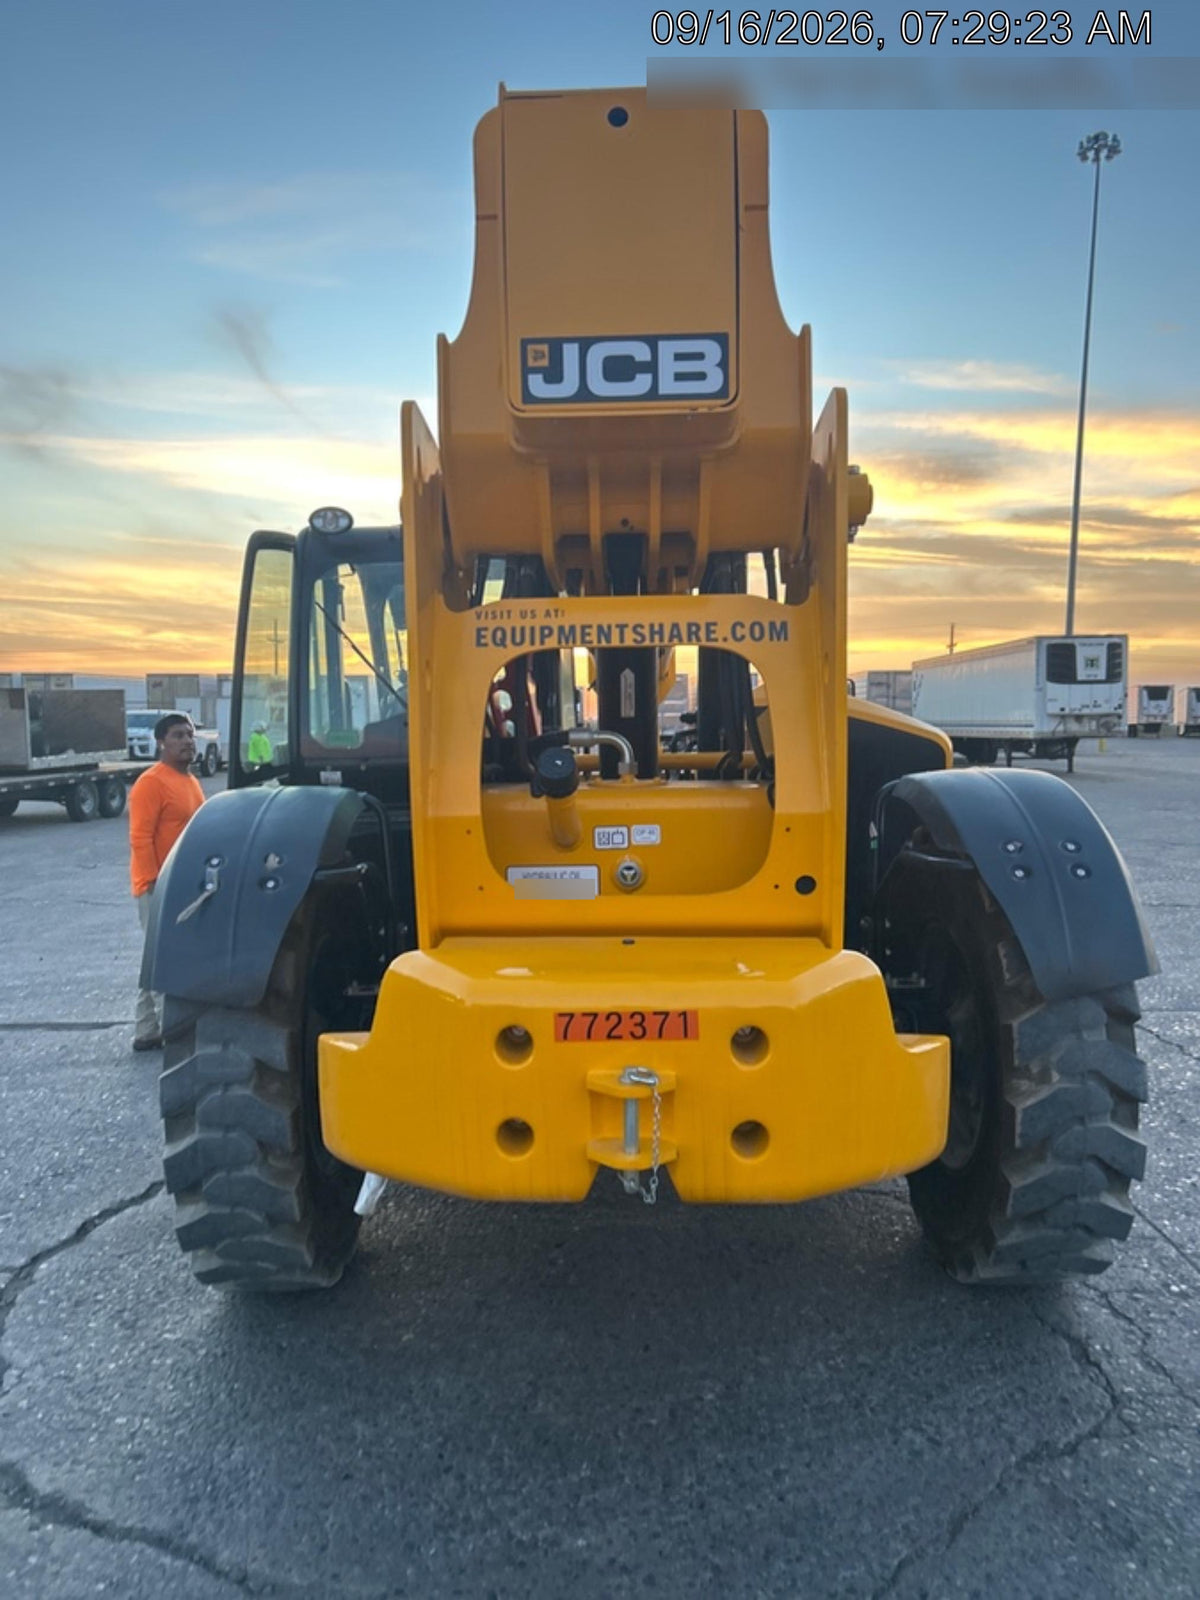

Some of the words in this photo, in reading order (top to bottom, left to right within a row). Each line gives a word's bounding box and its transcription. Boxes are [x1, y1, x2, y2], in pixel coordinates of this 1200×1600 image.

[527, 339, 724, 399] JCB
[474, 609, 512, 620] VISIT
[519, 608, 537, 619] US
[544, 608, 565, 619] AT:
[475, 621, 789, 648] EQUIPMENTSHARE.COM
[557, 1010, 689, 1040] 772371
